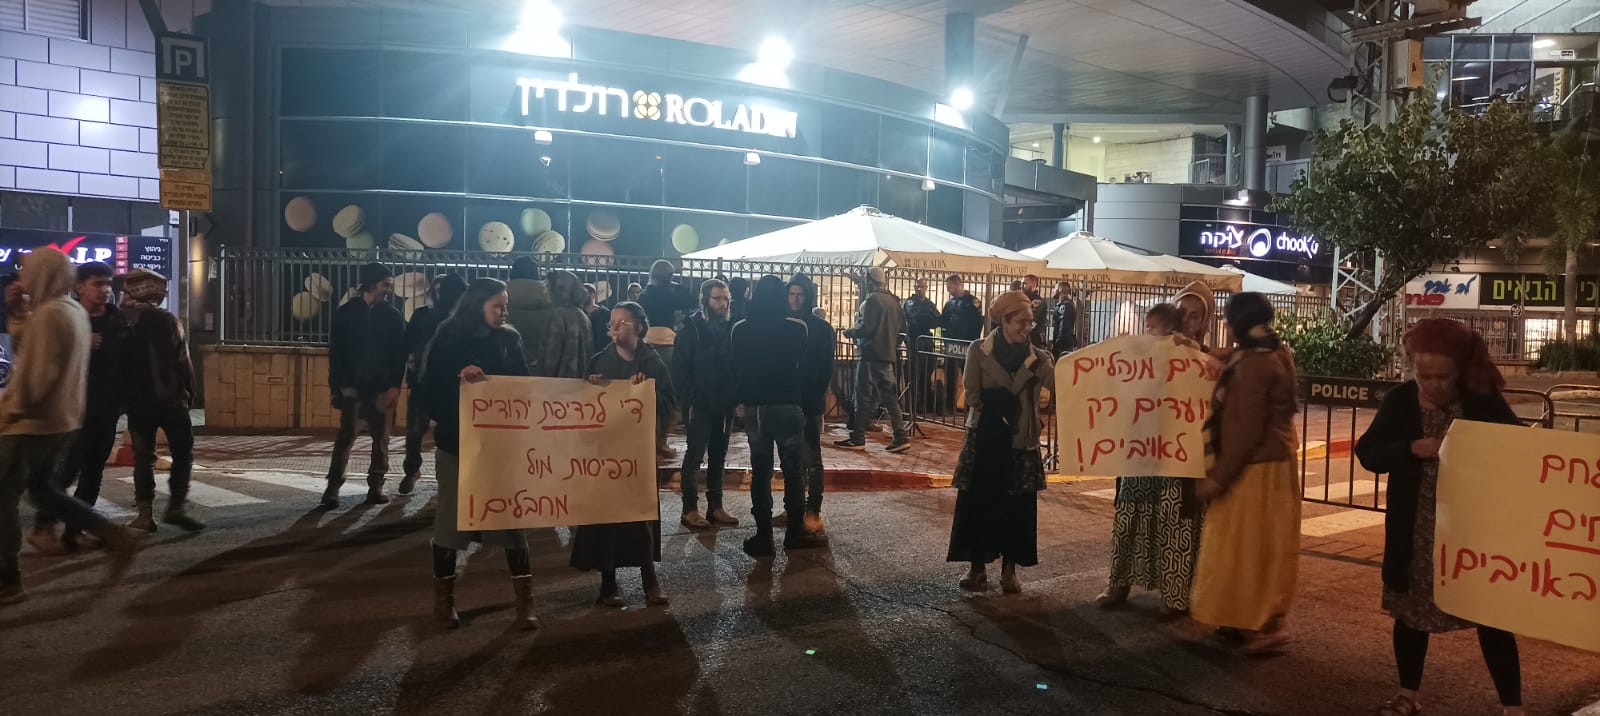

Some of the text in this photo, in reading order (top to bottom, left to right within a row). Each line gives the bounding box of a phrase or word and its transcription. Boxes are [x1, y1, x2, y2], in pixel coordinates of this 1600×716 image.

[175, 48, 192, 76] P
[516, 72, 629, 118] רולדין
[665, 94, 798, 139] ROLADIN
[1492, 278, 1557, 301] הבאים
[1073, 351, 1154, 386] מנהליים
[472, 391, 644, 425] די לרדיפת יהודים
[1311, 382, 1369, 401] POLICE
[1086, 396, 1119, 430] רק
[526, 447, 638, 481] ורפיסות מול
